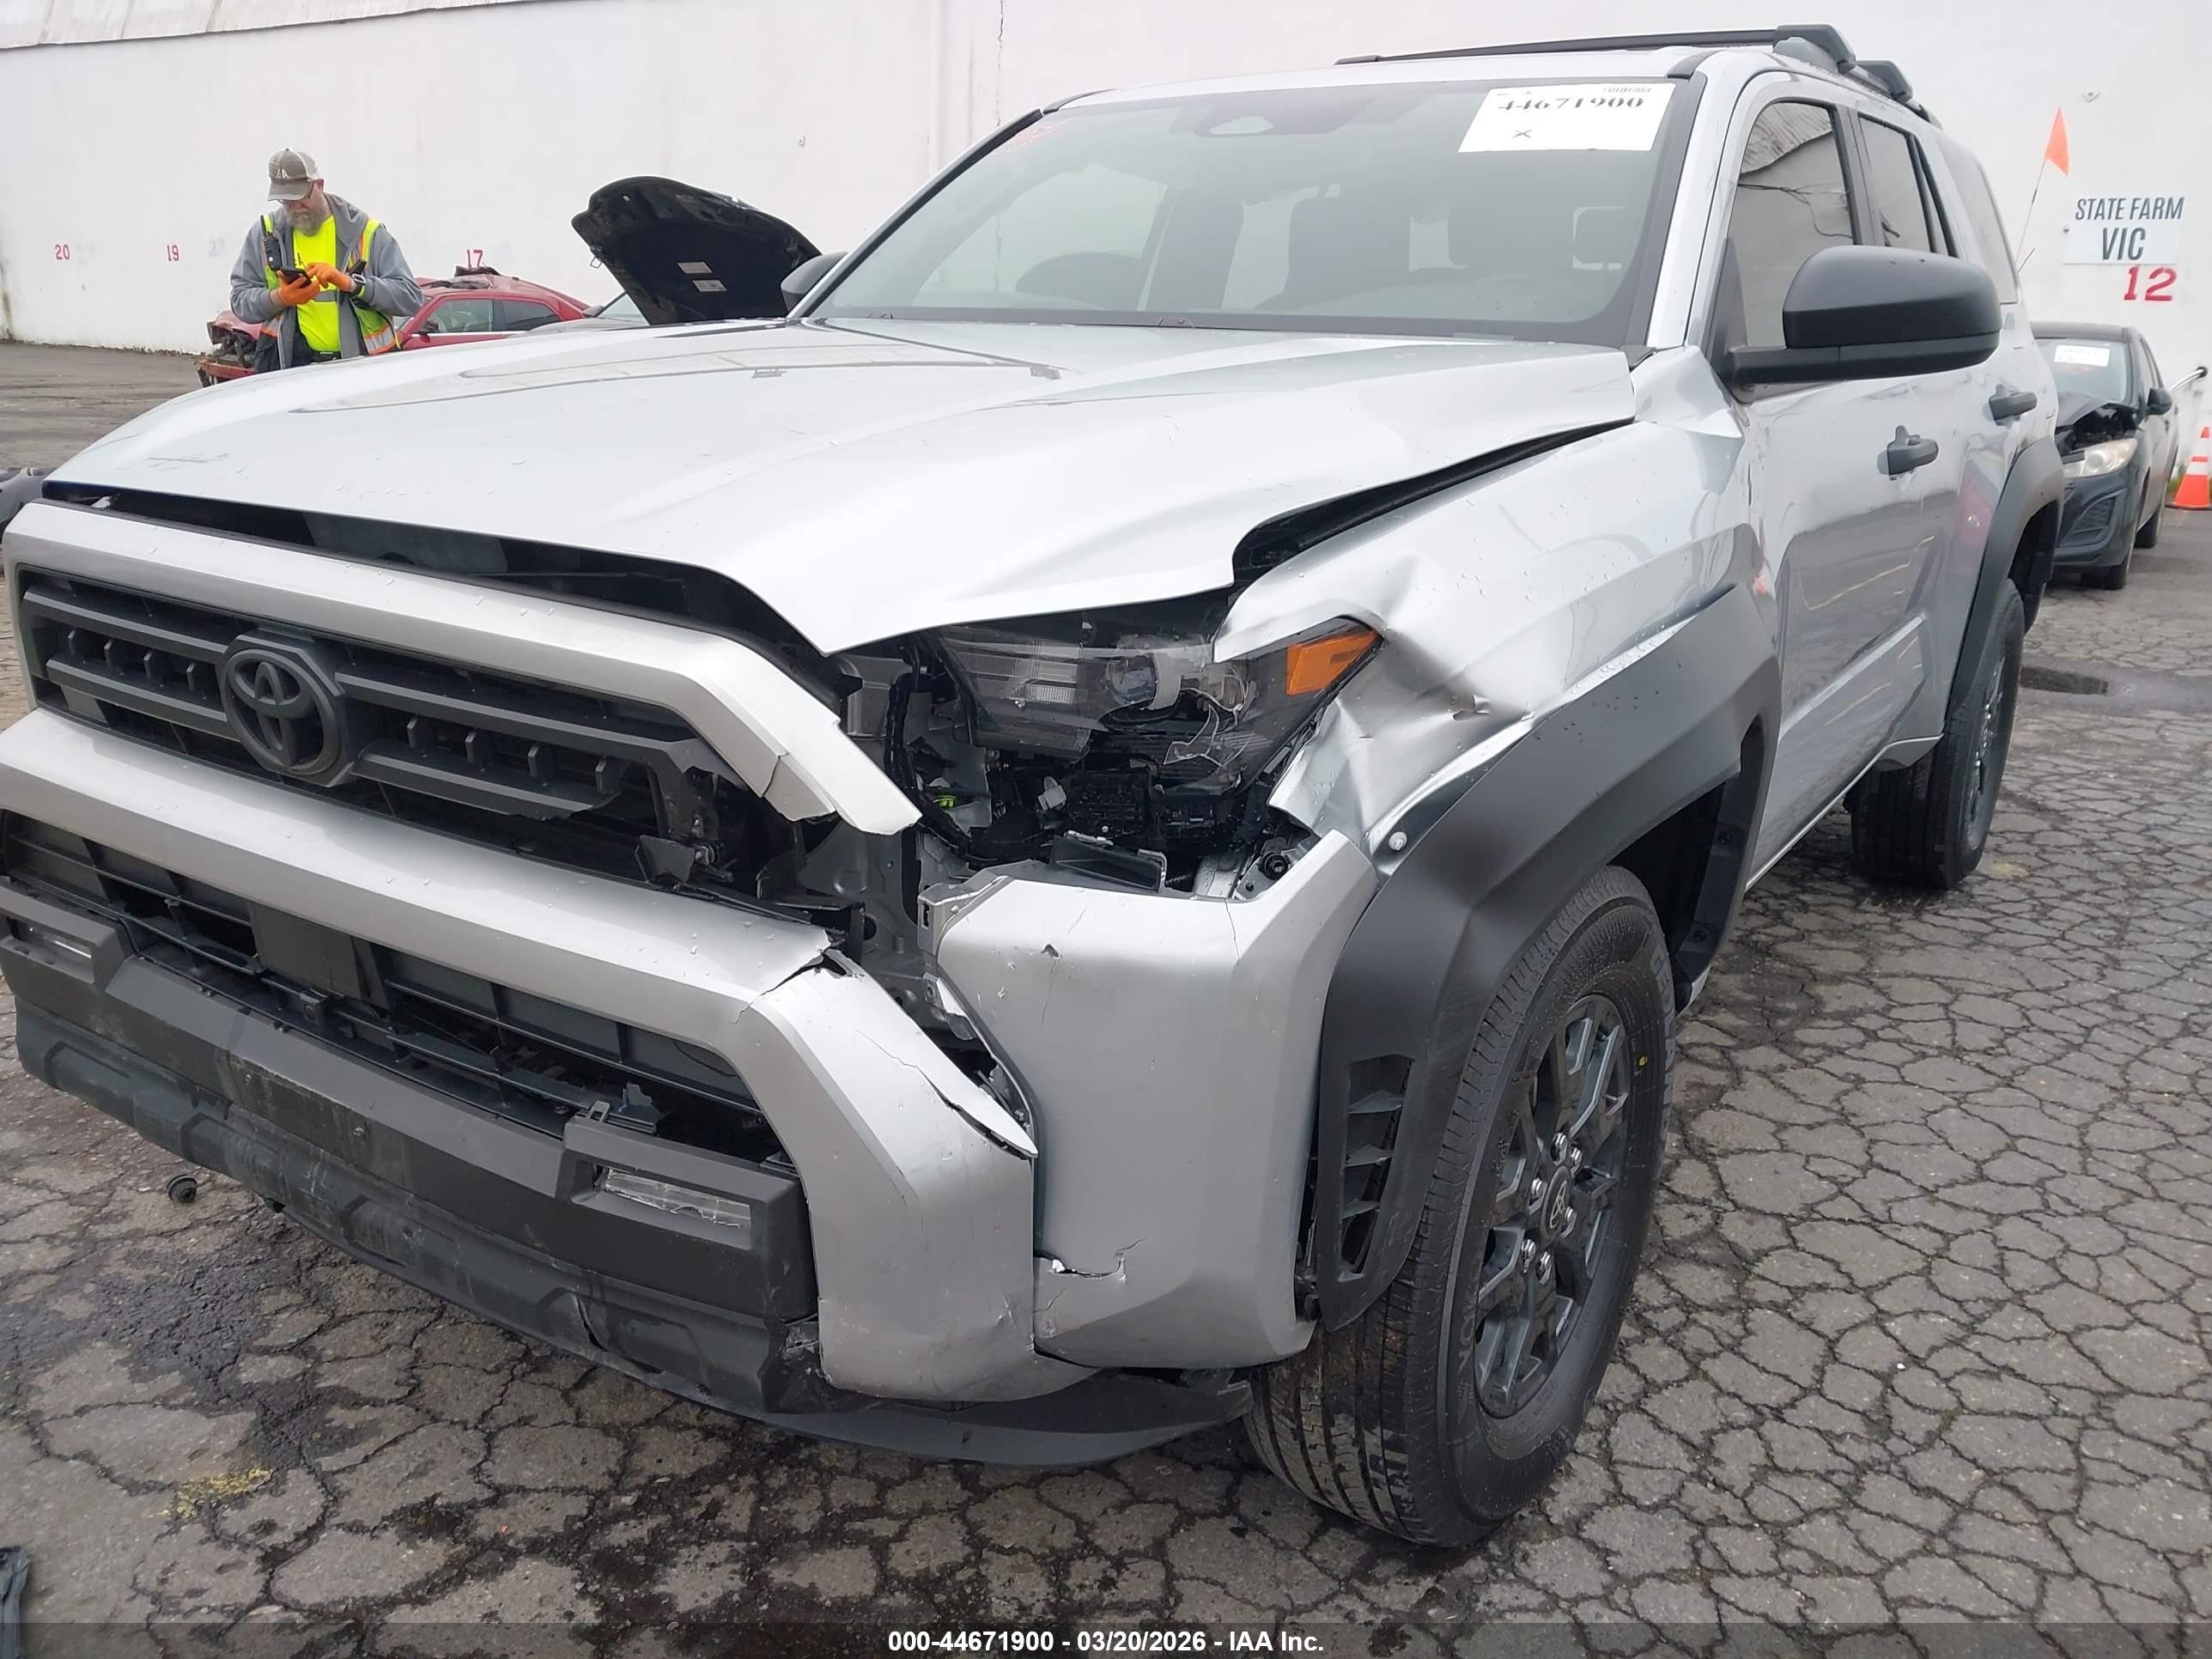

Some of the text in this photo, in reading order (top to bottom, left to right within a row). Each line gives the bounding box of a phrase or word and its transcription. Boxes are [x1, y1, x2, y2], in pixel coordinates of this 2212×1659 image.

[1498, 98, 1644, 110] 44671900
[2075, 198, 2185, 220] STATE FARM
[55, 245, 70, 259] 20
[167, 246, 179, 261] 19
[2103, 228, 2145, 260] VIC
[467, 249, 483, 269] 17
[2124, 265, 2176, 301] 12
